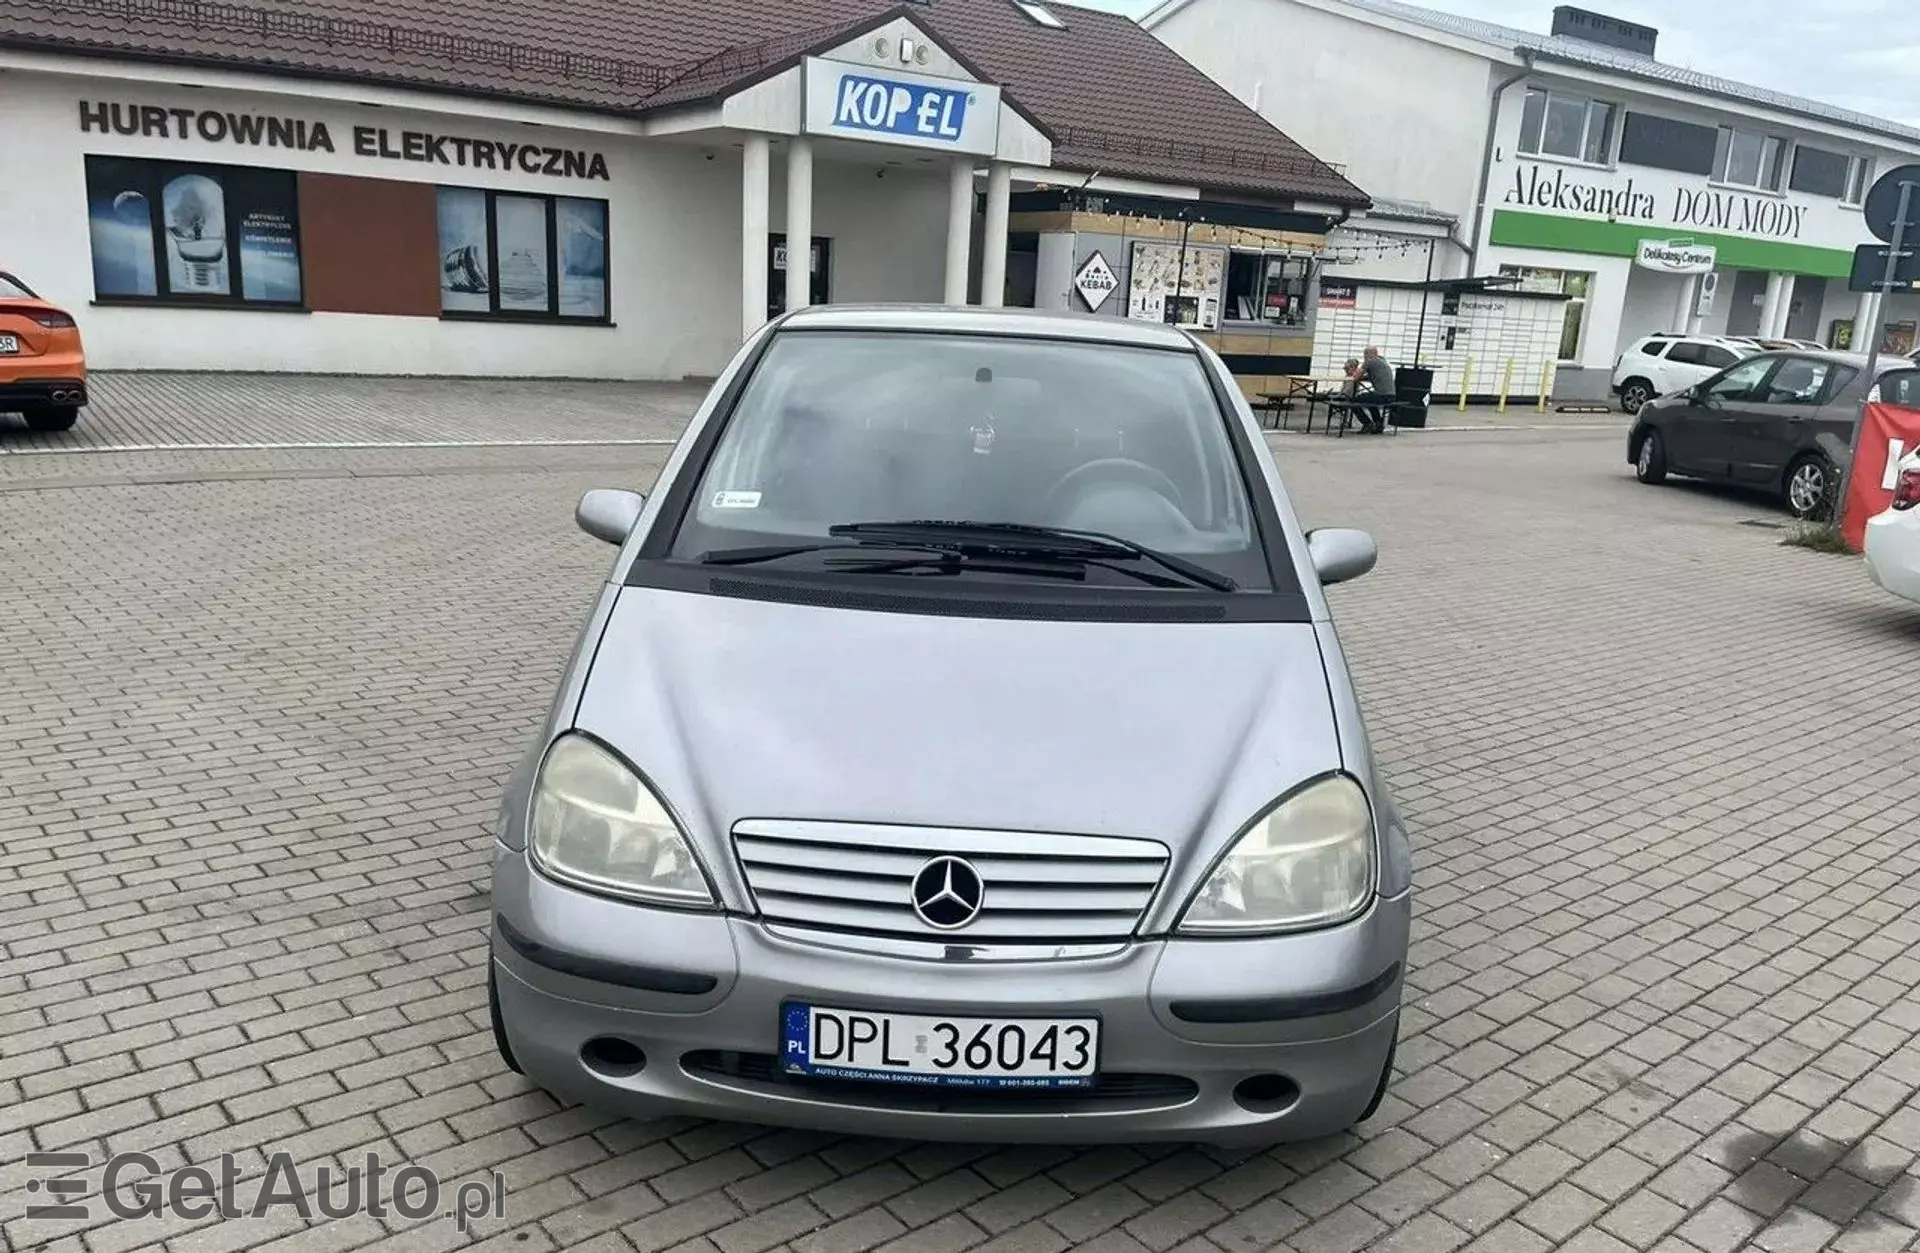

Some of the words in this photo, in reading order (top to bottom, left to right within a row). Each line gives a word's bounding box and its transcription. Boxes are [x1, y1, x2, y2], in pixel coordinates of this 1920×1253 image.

[79, 100, 335, 152] HURTOWNIA
[353, 125, 610, 180] ELEKTRYCZNA
[1504, 164, 1655, 219] Aleksandra
[1672, 187, 1734, 228] DOM
[1737, 197, 1808, 238] MODY
[1643, 247, 1681, 264] Delikatesy
[1682, 251, 1712, 264] Centrum
[1080, 280, 1112, 290] KEBAB
[788, 1040, 806, 1055] PL
[814, 1012, 909, 1066] DPL
[932, 1022, 1090, 1071] 36043
[815, 1067, 837, 1076] AUTO
[838, 1069, 867, 1079] CZĘŚCI
[867, 1072, 890, 1081] ANNA
[976, 1078, 991, 1086] 177
